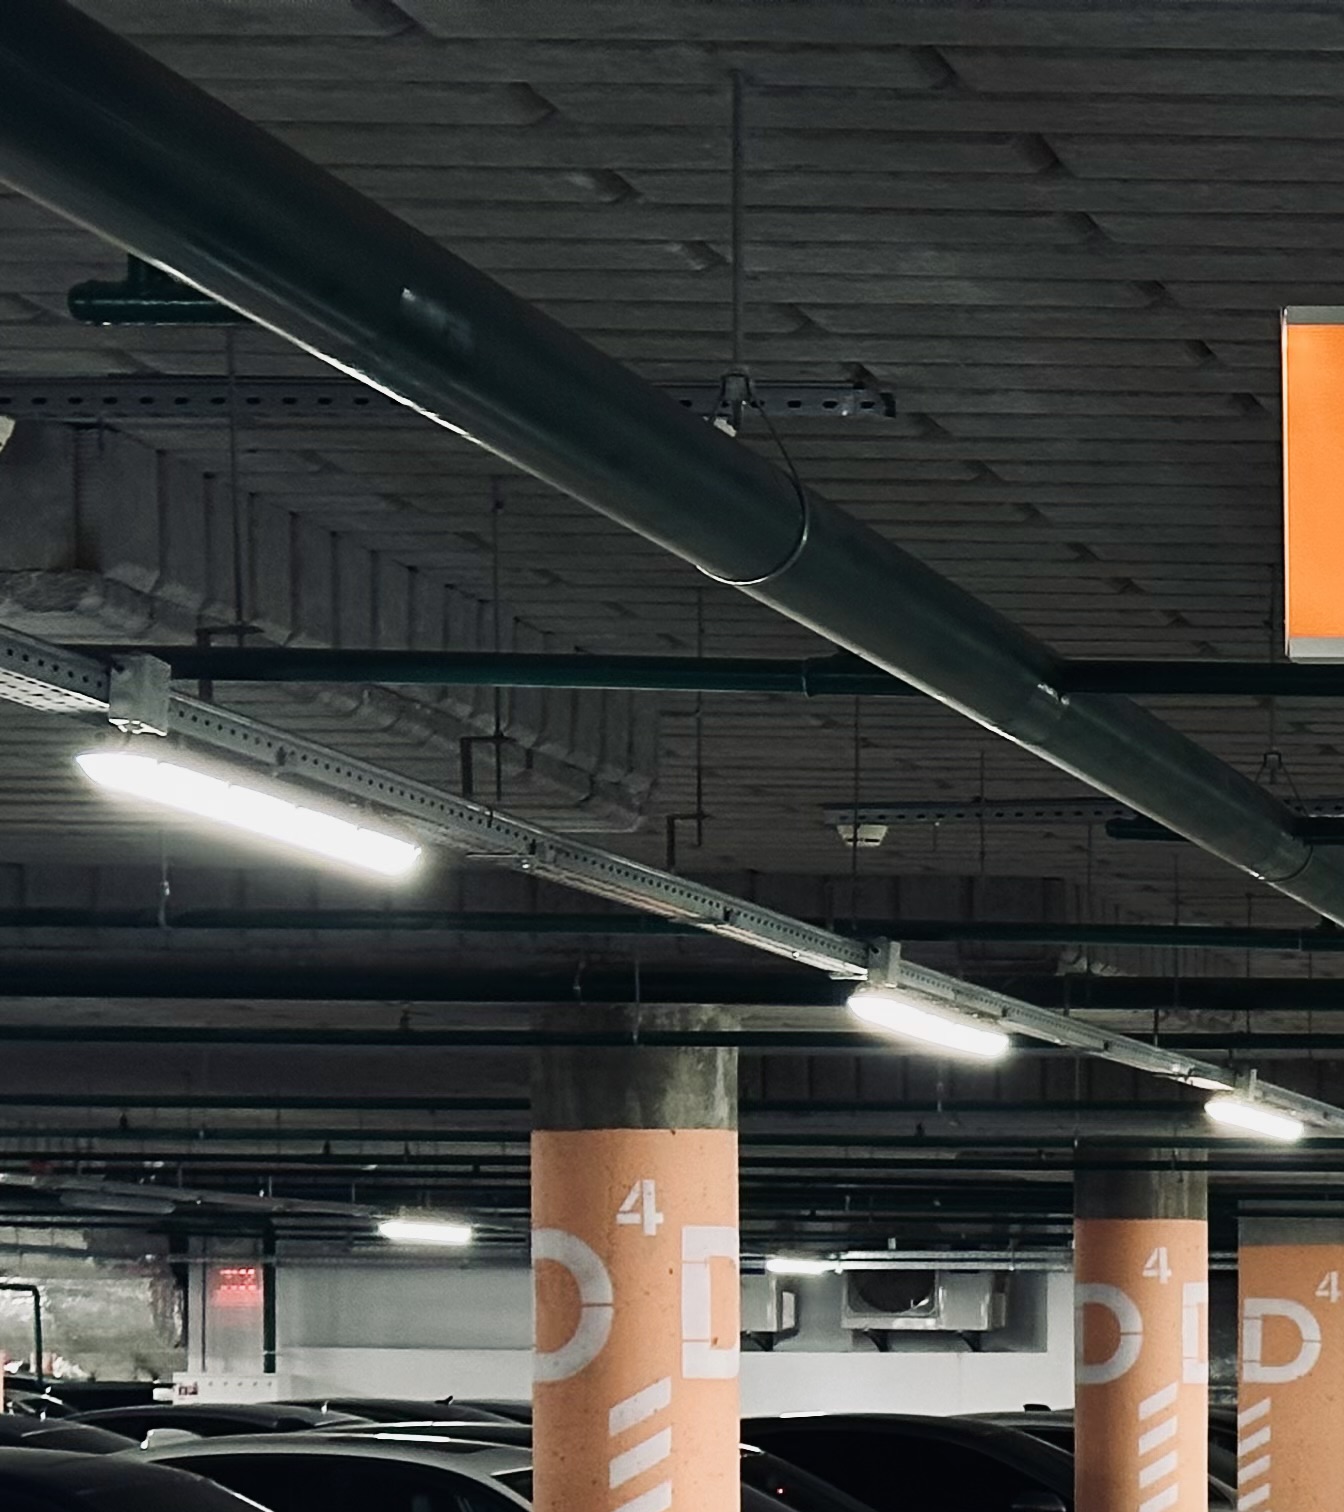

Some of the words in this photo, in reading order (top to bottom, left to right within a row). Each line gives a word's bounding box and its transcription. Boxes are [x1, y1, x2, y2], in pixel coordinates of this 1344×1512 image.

[616, 1179, 664, 1237] 4
[1142, 1247, 1172, 1284] 4
[1315, 1271, 1342, 1303] 4
[1076, 1283, 1143, 1385] D
[1243, 1298, 1322, 1384] D
